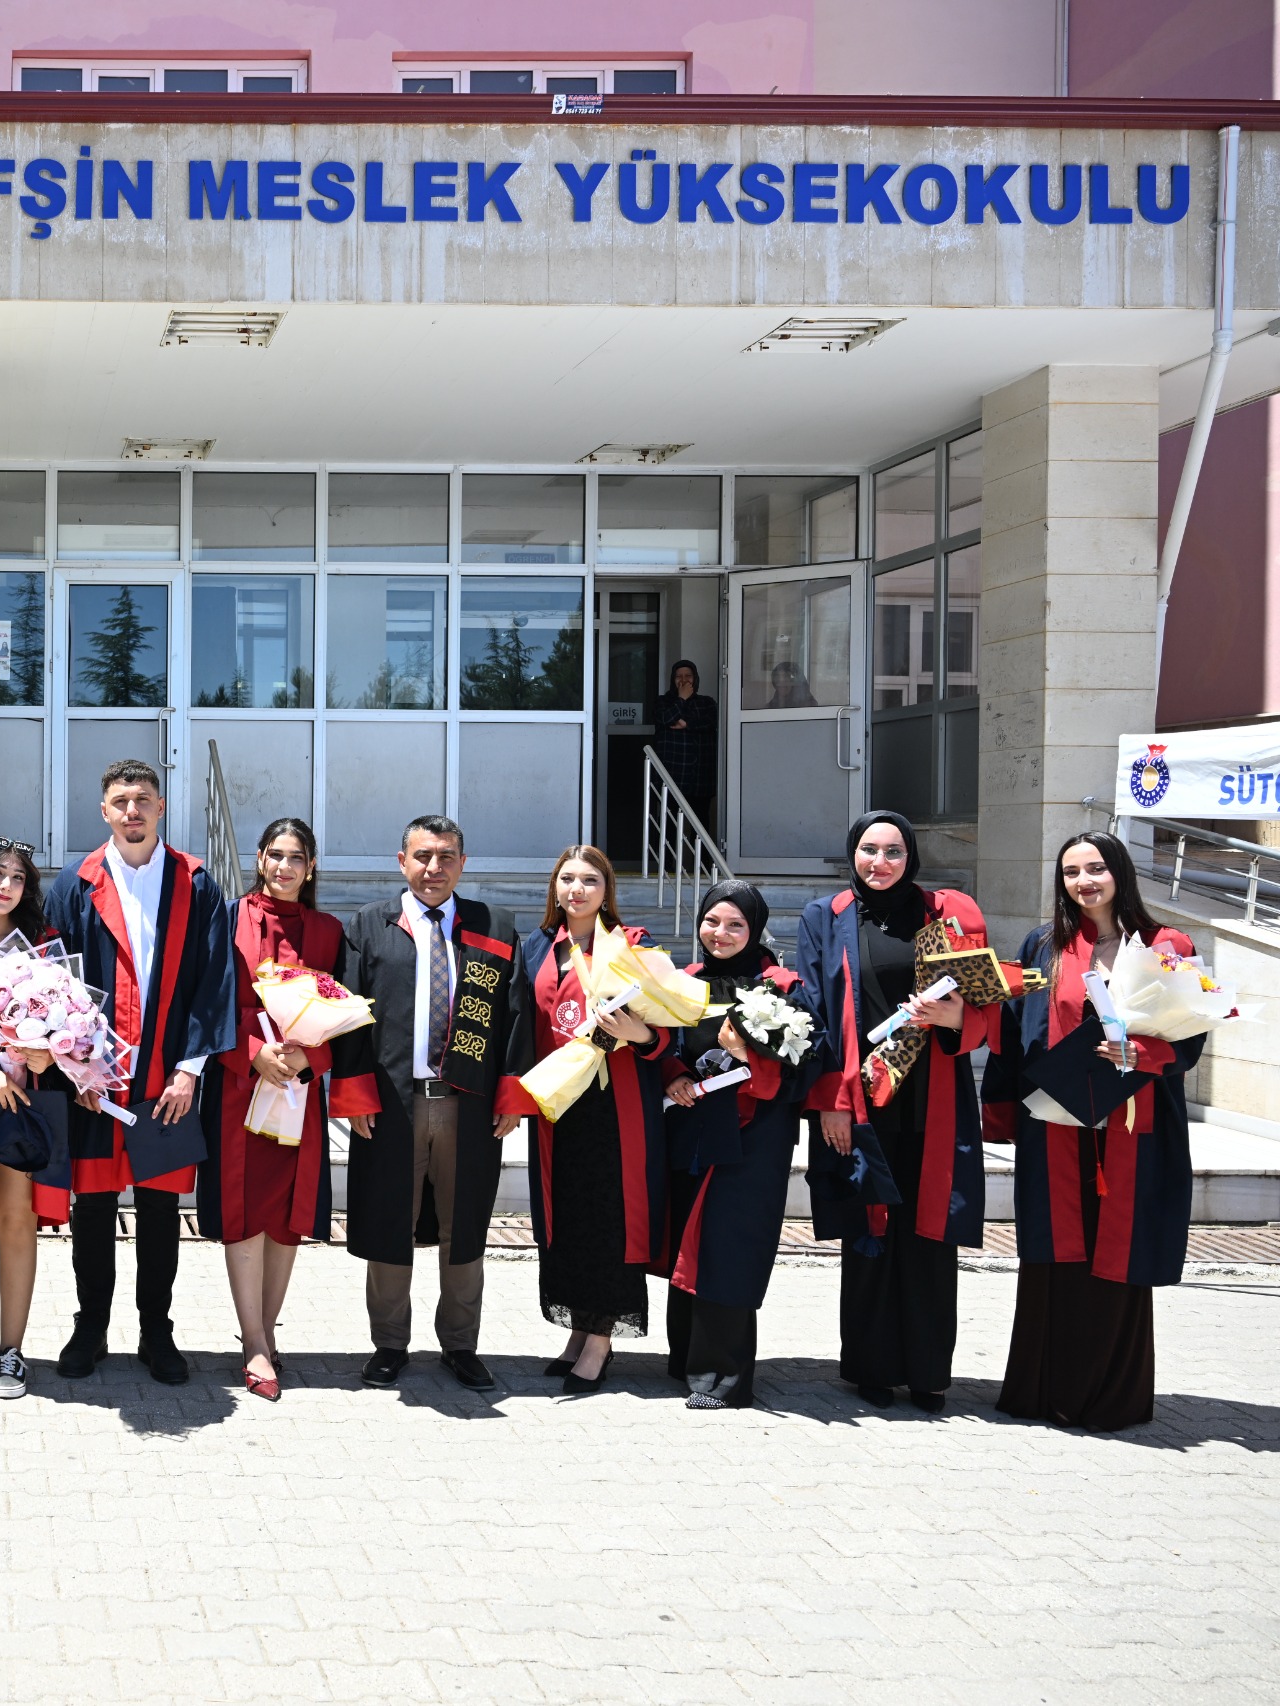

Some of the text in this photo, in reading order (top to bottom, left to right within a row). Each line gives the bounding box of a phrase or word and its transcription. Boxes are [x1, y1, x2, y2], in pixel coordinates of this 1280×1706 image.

[188, 159, 523, 223] MESLEK
[555, 149, 1190, 226] YÜKSEKOKULU
[612, 707, 637, 718] GİRİŞ
